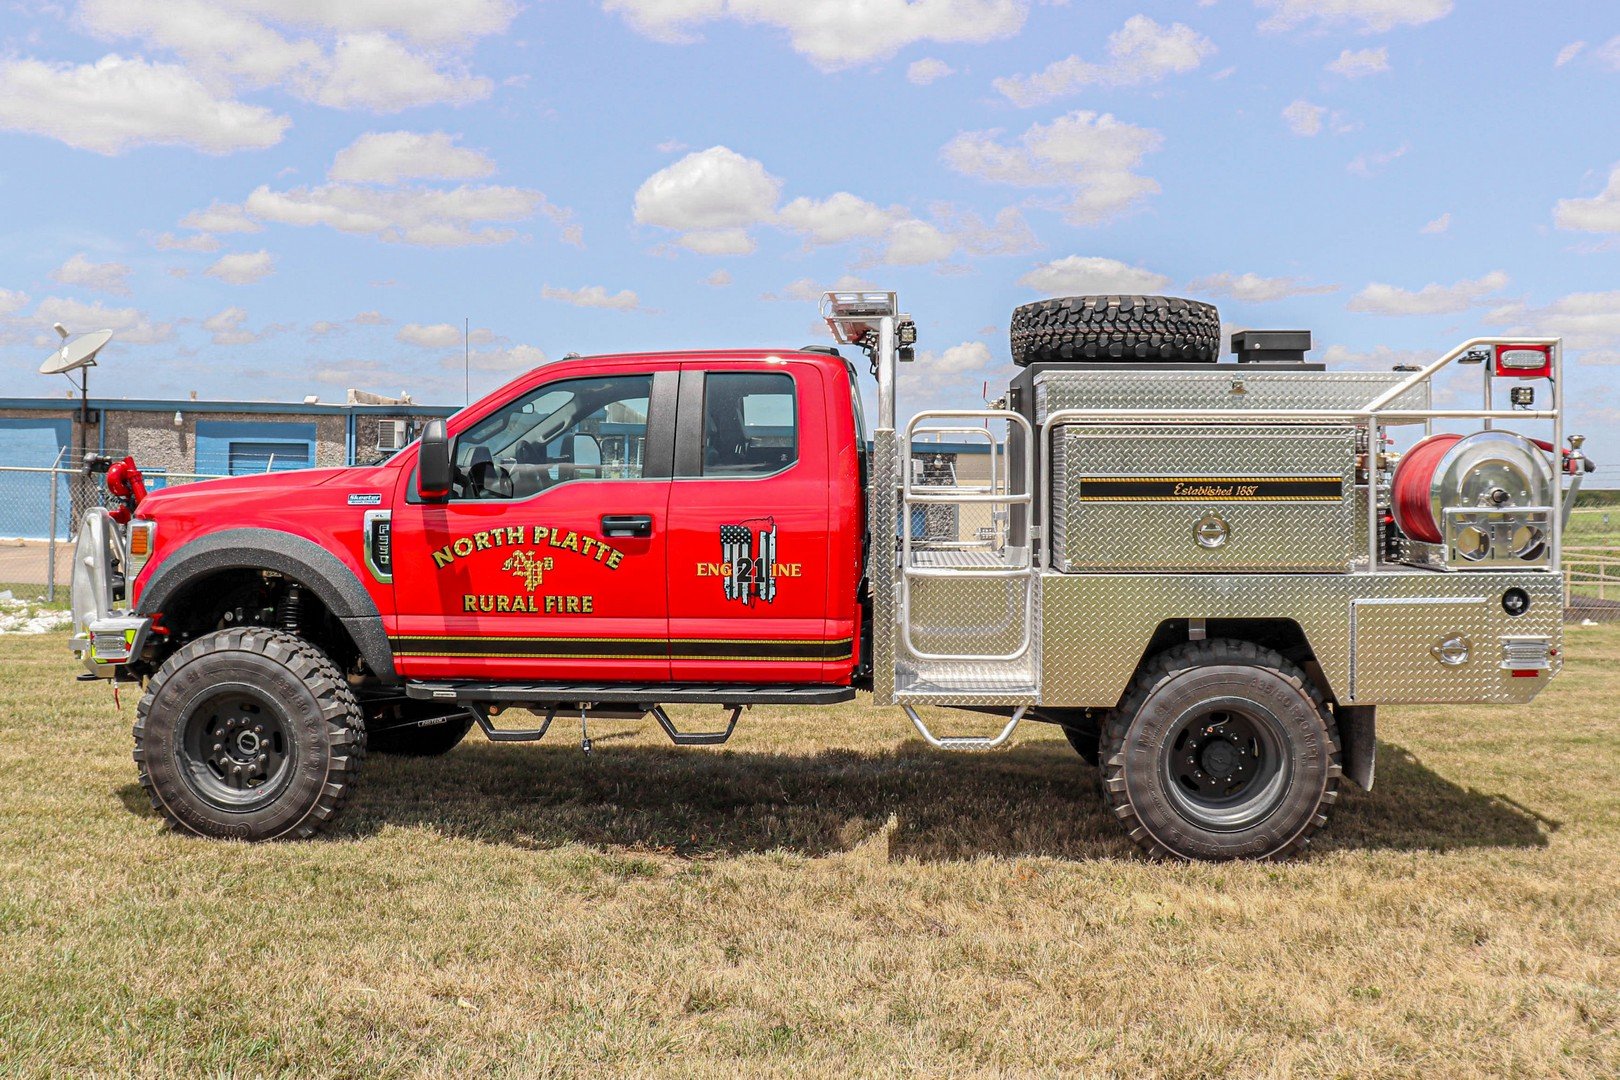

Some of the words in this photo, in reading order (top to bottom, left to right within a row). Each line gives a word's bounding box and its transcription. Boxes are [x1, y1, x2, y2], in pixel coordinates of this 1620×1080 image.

[1173, 482, 1234, 496] Established
[1235, 485, 1259, 496] 1887
[378, 524, 390, 565] F550
[432, 525, 525, 569] NORTH
[533, 525, 625, 570] PLATTE
[736, 556, 766, 584] 21
[463, 594, 539, 613] RURAL
[544, 595, 593, 613] FIRE
